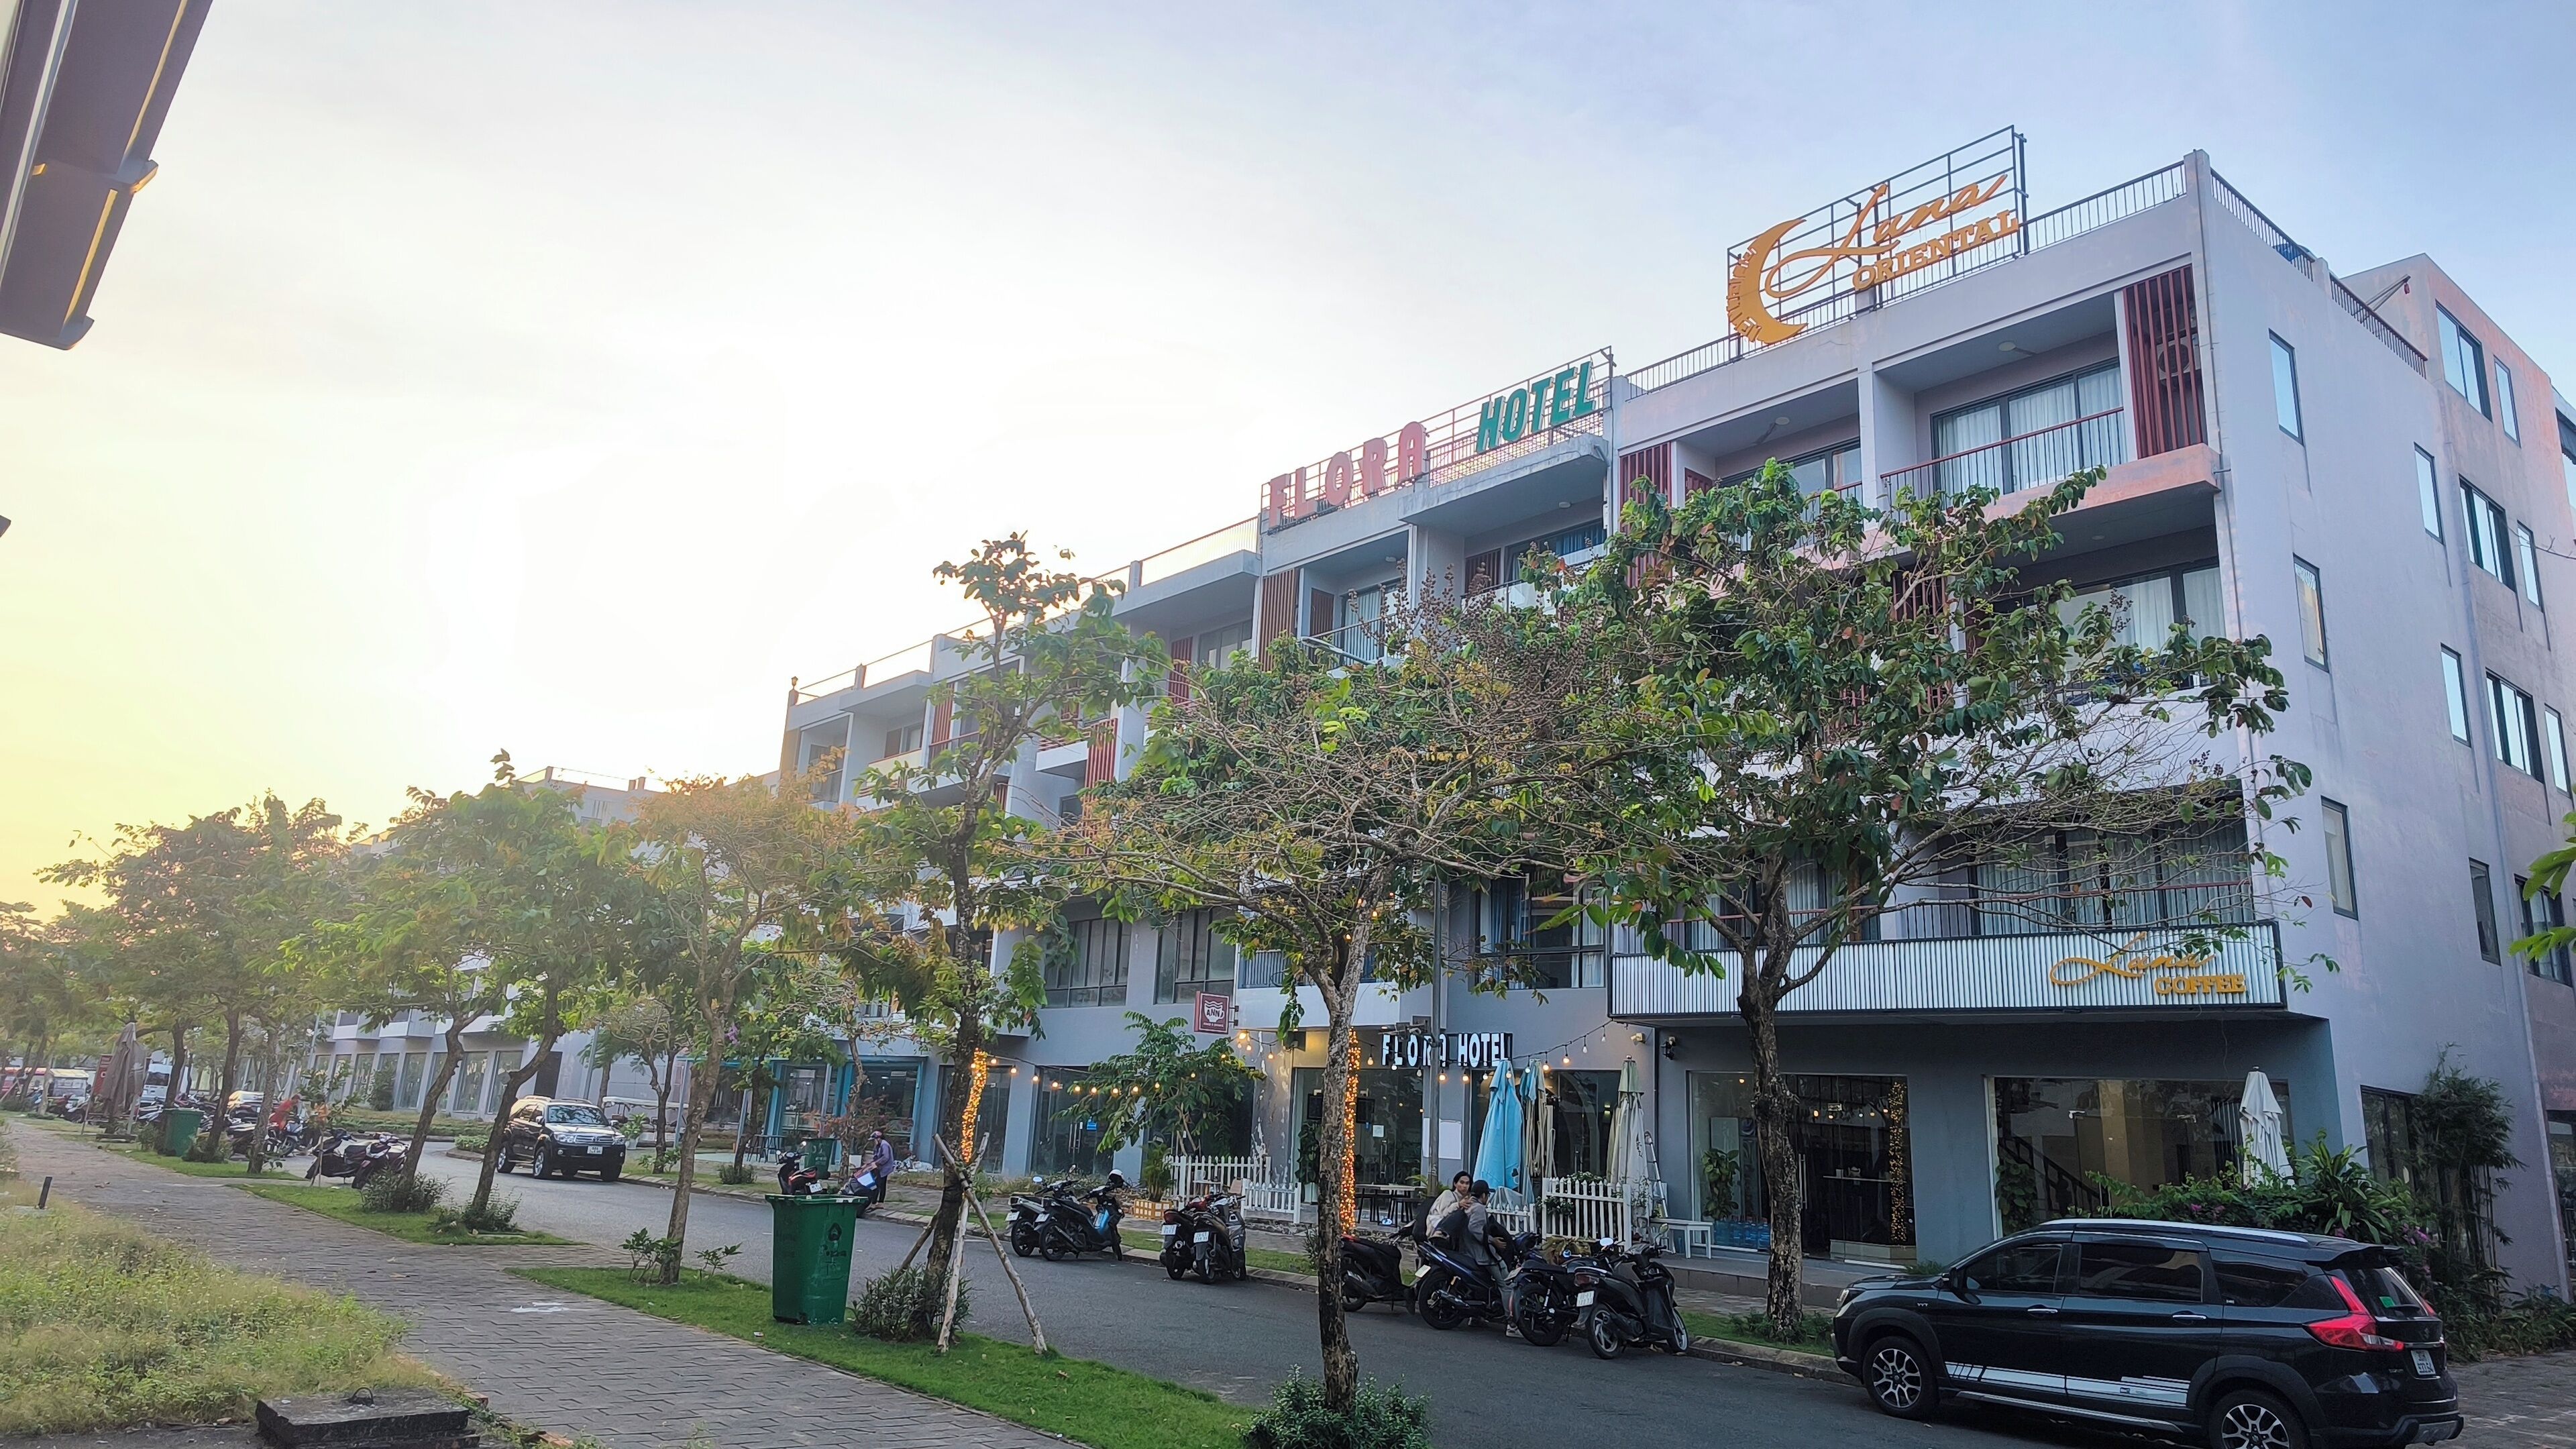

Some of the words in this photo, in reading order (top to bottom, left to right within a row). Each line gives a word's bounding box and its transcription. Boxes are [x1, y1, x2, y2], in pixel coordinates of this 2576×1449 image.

[1852, 209, 2019, 290] ORIENTAL
[1269, 421, 1427, 528] FLORA
[1476, 360, 1597, 454] HOTEL
[2155, 974, 2247, 995] COFFEE
[1207, 1008, 1220, 1018] ANN
[1457, 1032, 1509, 1067] HOTEL
